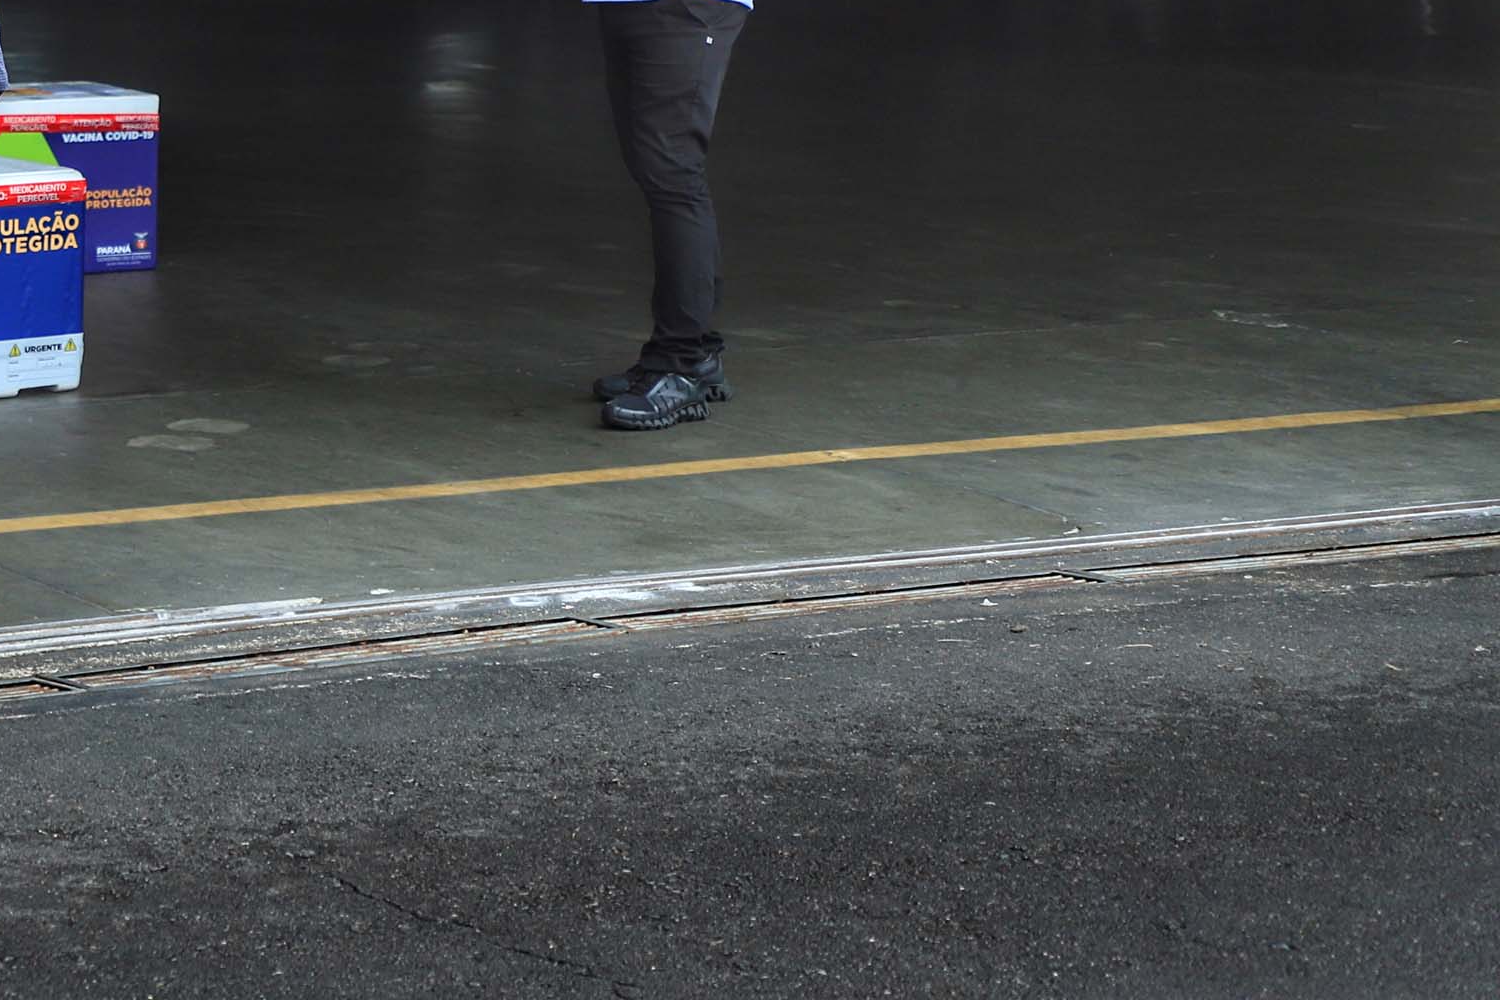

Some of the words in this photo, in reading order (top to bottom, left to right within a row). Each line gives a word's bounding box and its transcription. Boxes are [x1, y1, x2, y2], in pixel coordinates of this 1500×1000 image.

[62, 132, 104, 144] VACINA
[106, 130, 155, 142] COVID-19
[10, 182, 67, 195] MEDICAMENTO
[85, 185, 153, 200] POPULAÇÃO
[16, 192, 60, 203] PERECÍVEL
[85, 197, 152, 211] PROTEGIDA
[96, 243, 132, 256] PARANÁ
[24, 343, 63, 354] URGENTE
